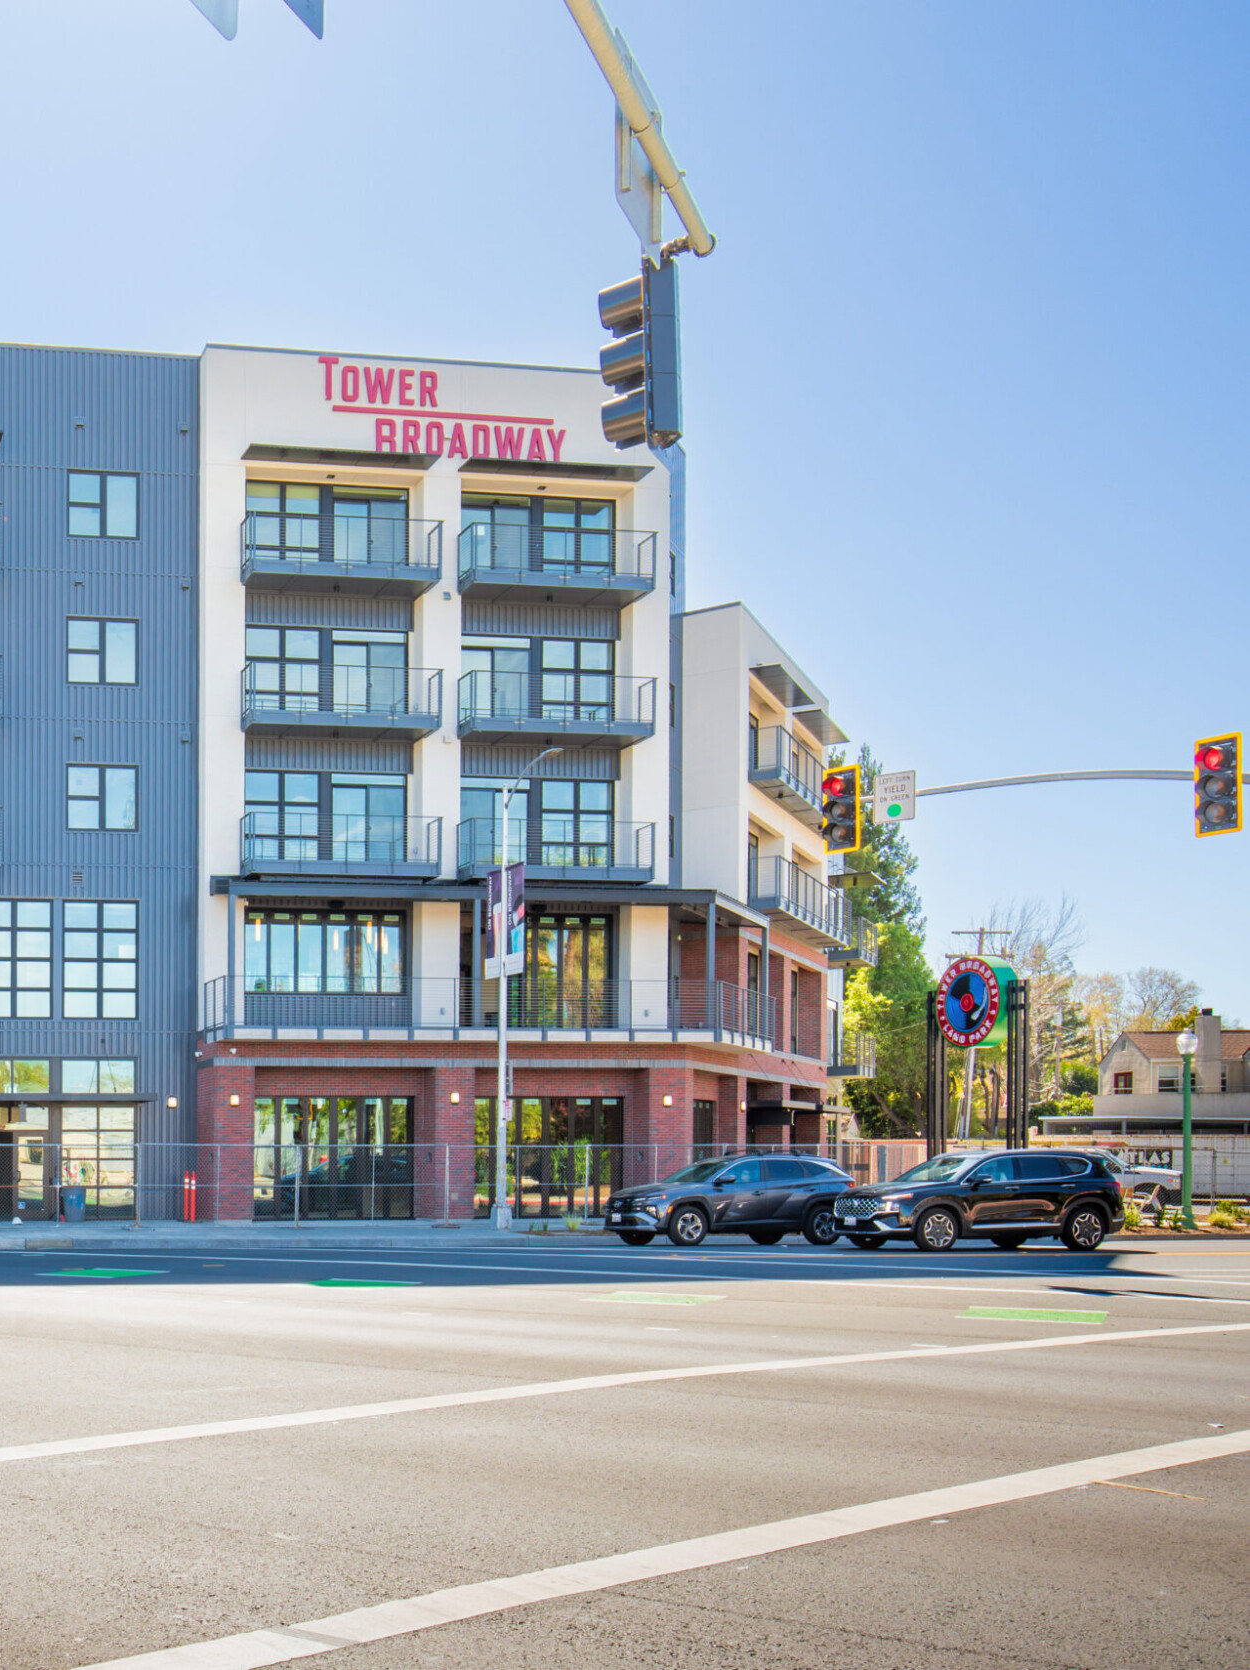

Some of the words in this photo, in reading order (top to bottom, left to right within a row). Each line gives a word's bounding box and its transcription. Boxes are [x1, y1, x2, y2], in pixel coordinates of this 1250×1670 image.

[318, 356, 438, 407] TOWER
[375, 418, 566, 462] BROADWAY
[884, 784, 905, 793] YIELD
[937, 969, 957, 1010] TOWER
[959, 960, 999, 1003] BROADWAY
[943, 1024, 966, 1044] LAND
[969, 1019, 993, 1043] PARK
